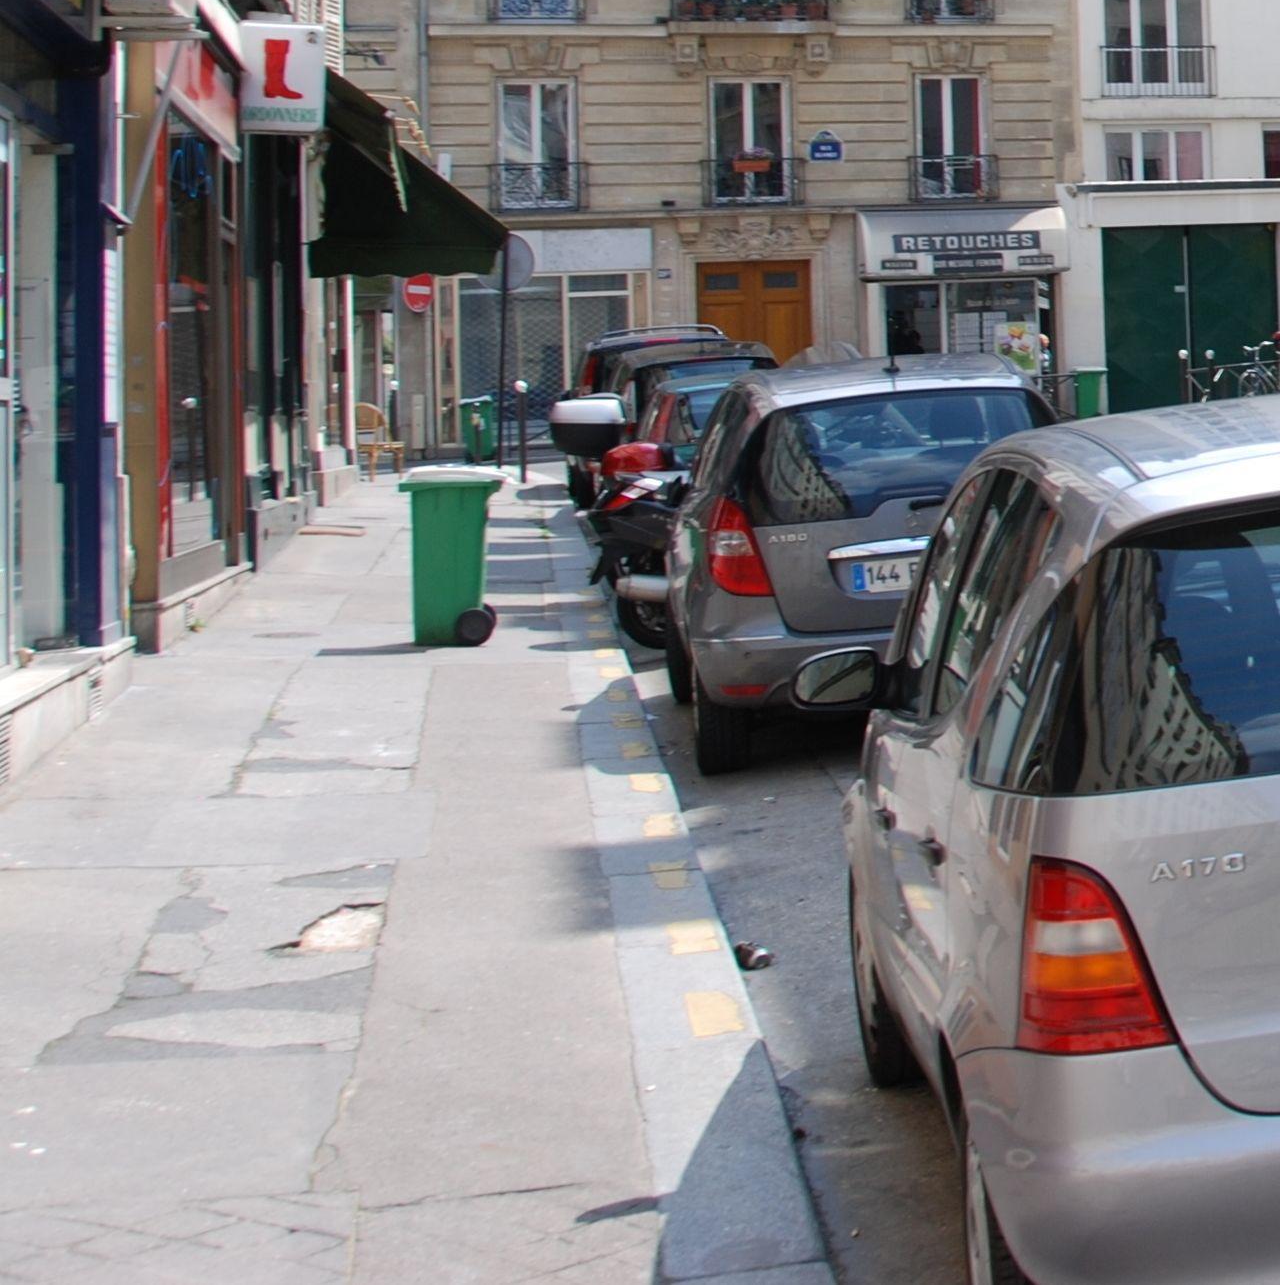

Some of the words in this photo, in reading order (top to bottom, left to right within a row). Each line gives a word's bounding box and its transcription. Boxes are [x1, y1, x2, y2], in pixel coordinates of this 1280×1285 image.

[901, 233, 1034, 251] RETOUCHES
[867, 563, 901, 585] 144
[1150, 852, 1246, 883] A170
